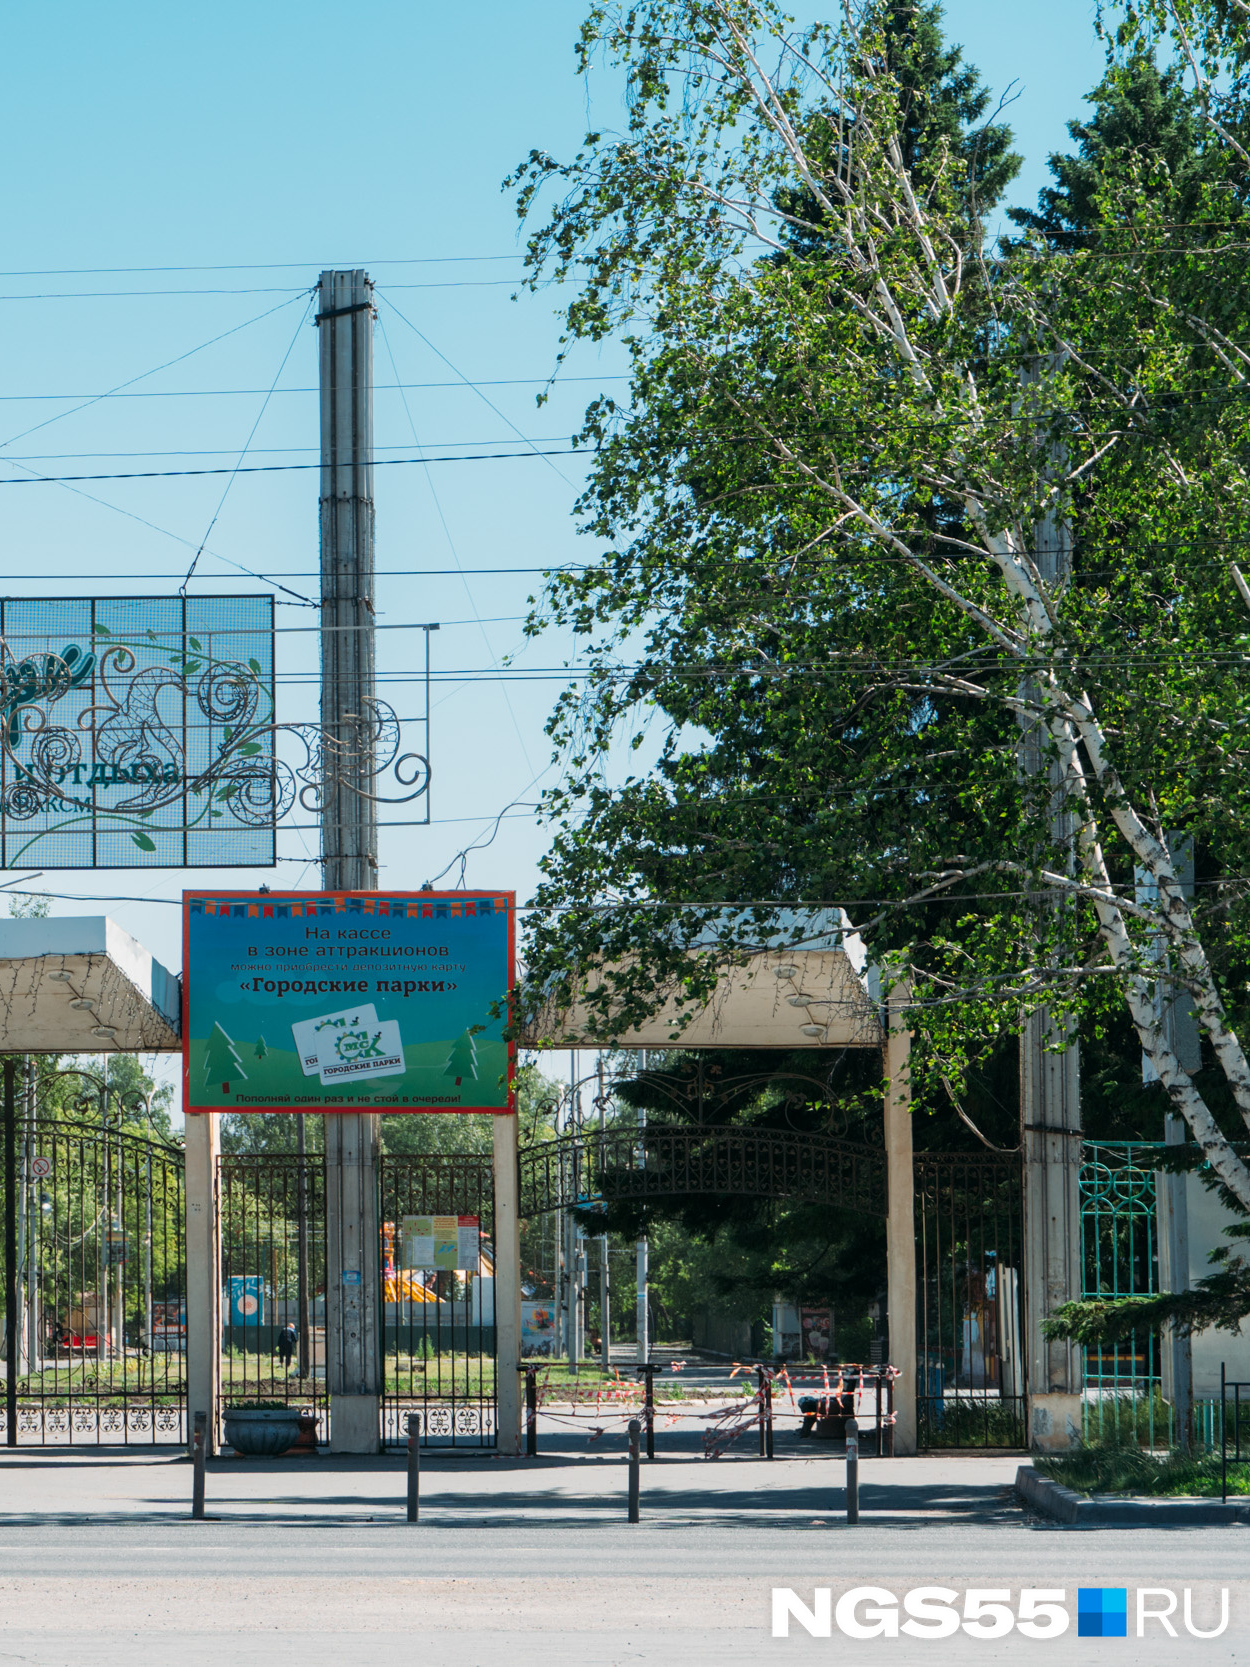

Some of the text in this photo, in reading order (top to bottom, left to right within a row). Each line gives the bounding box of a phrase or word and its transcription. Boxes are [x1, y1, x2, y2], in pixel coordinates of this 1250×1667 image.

[305, 927, 391, 939] На кассе
[248, 946, 449, 959] в зоне аттракционов
[231, 963, 466, 973] можно приобрести депозитную карту
[240, 978, 457, 997] «Городские парки»
[324, 1058, 401, 1074] ГОРОДСКИЕ ПАРКИ
[236, 1094, 290, 1103] Пополняй
[294, 1096, 321, 1104] один
[324, 1096, 344, 1104] раз
[374, 1094, 399, 1103] стой
[412, 1094, 461, 1104] очереди!
